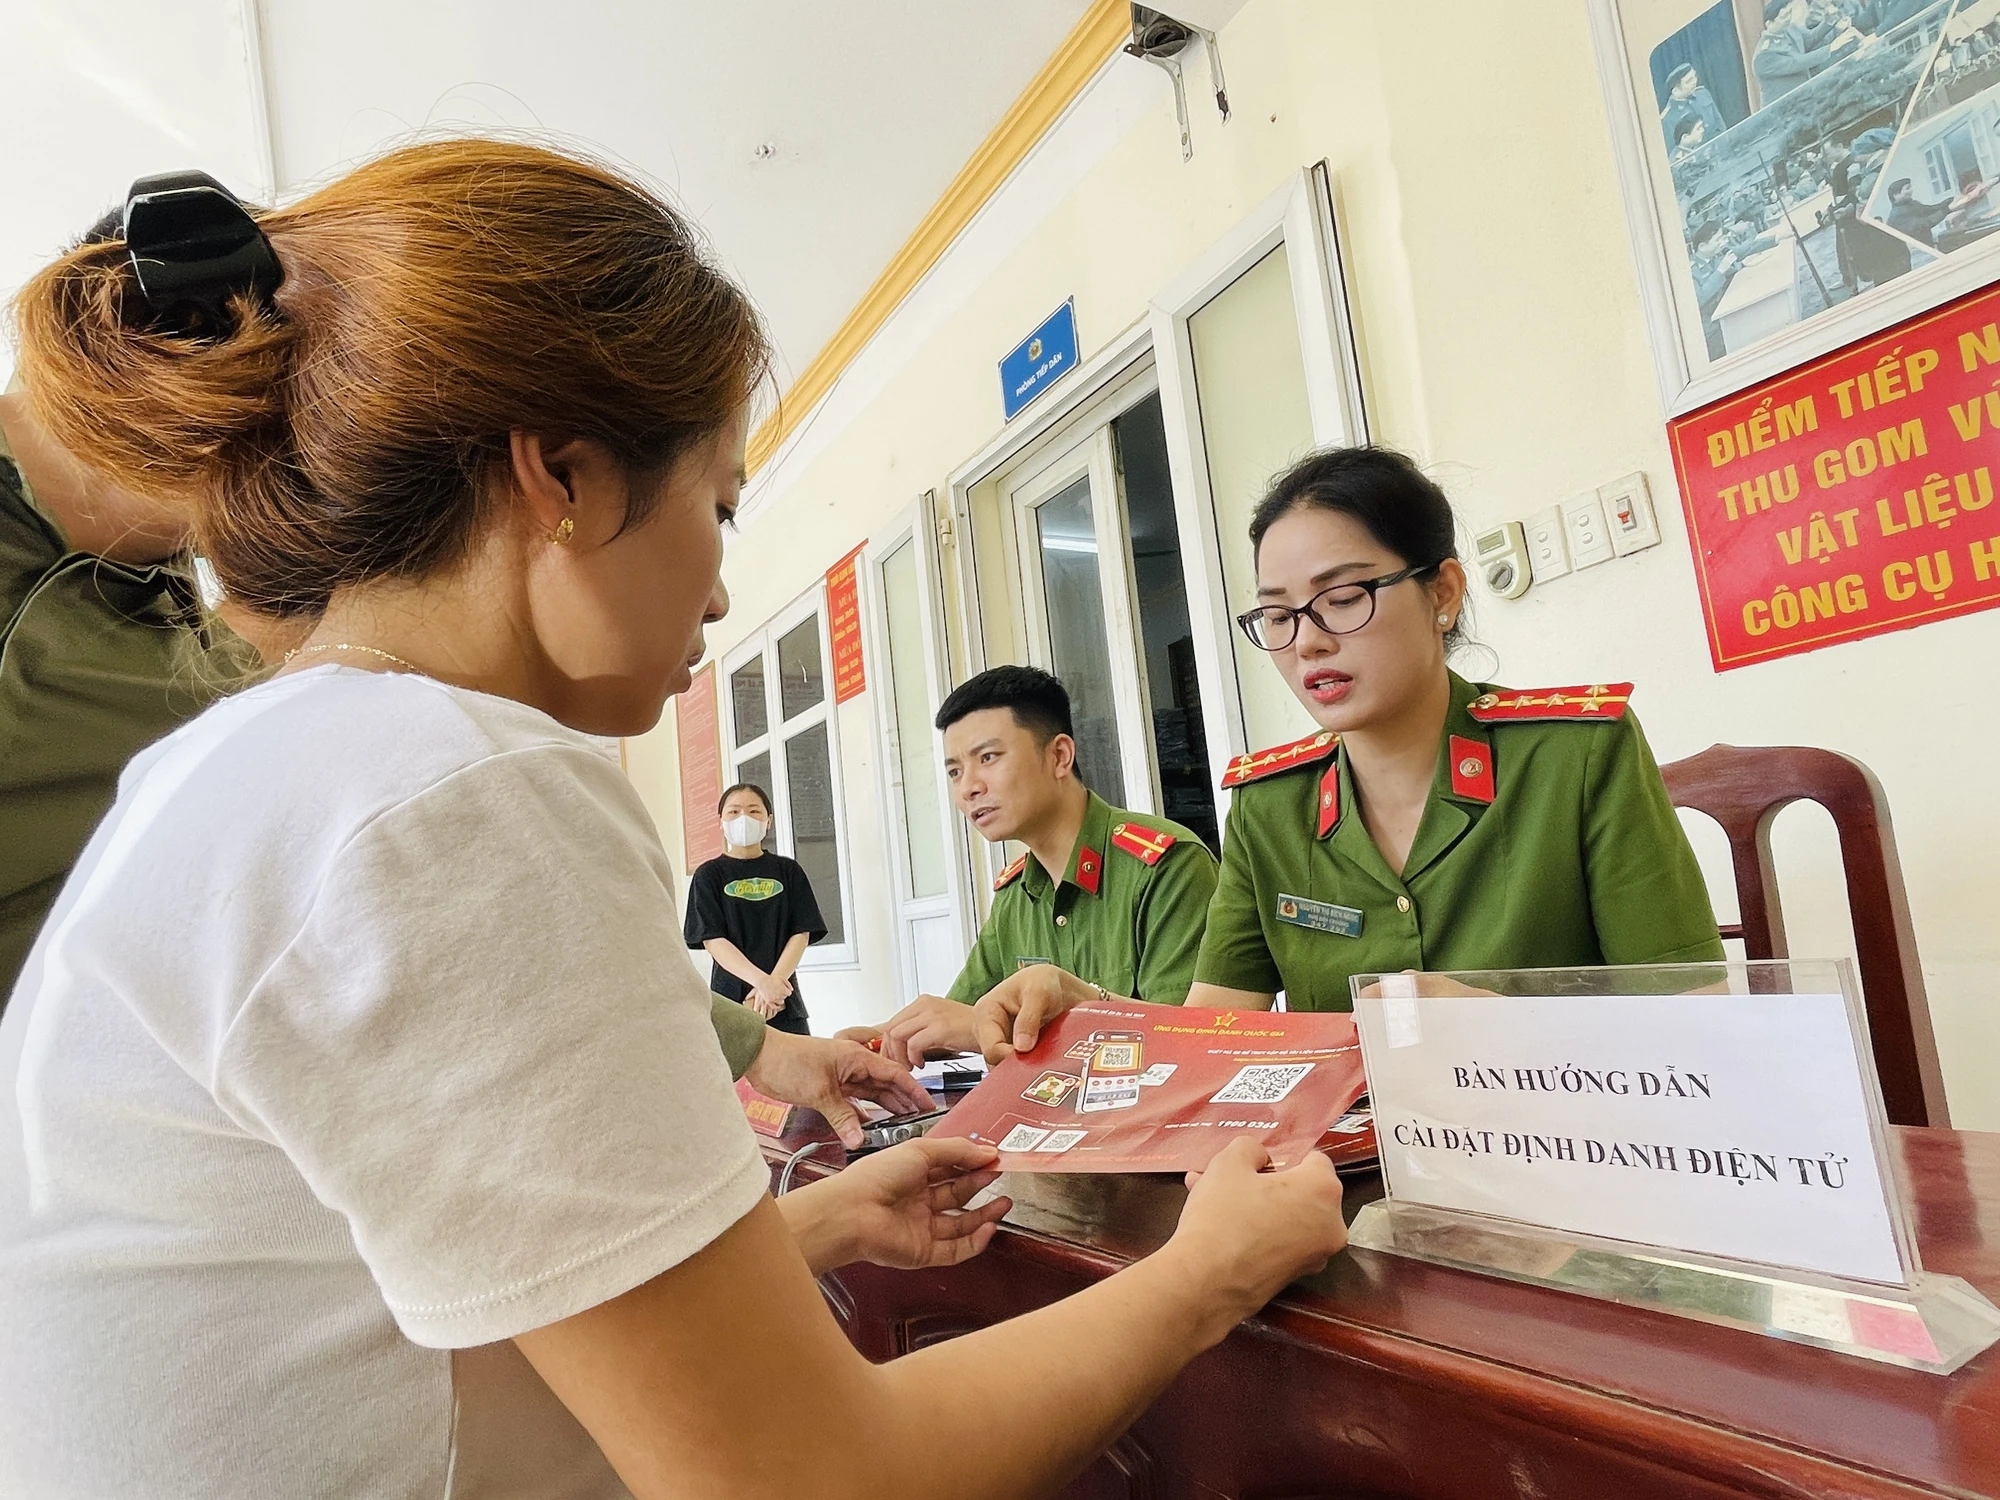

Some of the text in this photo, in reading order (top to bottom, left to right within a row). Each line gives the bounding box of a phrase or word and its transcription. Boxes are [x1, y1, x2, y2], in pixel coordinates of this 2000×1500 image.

[1048, 352, 1063, 370] DÂN
[1708, 397, 1818, 468] ĐIỂM
[1829, 345, 1939, 419] TIẾP
[1718, 464, 1800, 521] THU
[1814, 418, 1928, 489] GOM
[1775, 467, 1994, 565] VẬT LIỆU
[1743, 574, 1869, 636] CÔNG
[1882, 550, 1953, 601] CỤ
[1452, 1060, 1712, 1099] BÀN HƯỚNG DẪN
[1394, 1119, 1437, 1148] CÀI
[1441, 1126, 1495, 1158] ĐẶT
[1502, 1132, 1578, 1164] ĐỊNH
[1583, 1138, 1680, 1172] DANH
[1686, 1147, 1779, 1186] ĐIỆN
[1788, 1151, 1849, 1189] TỬ
